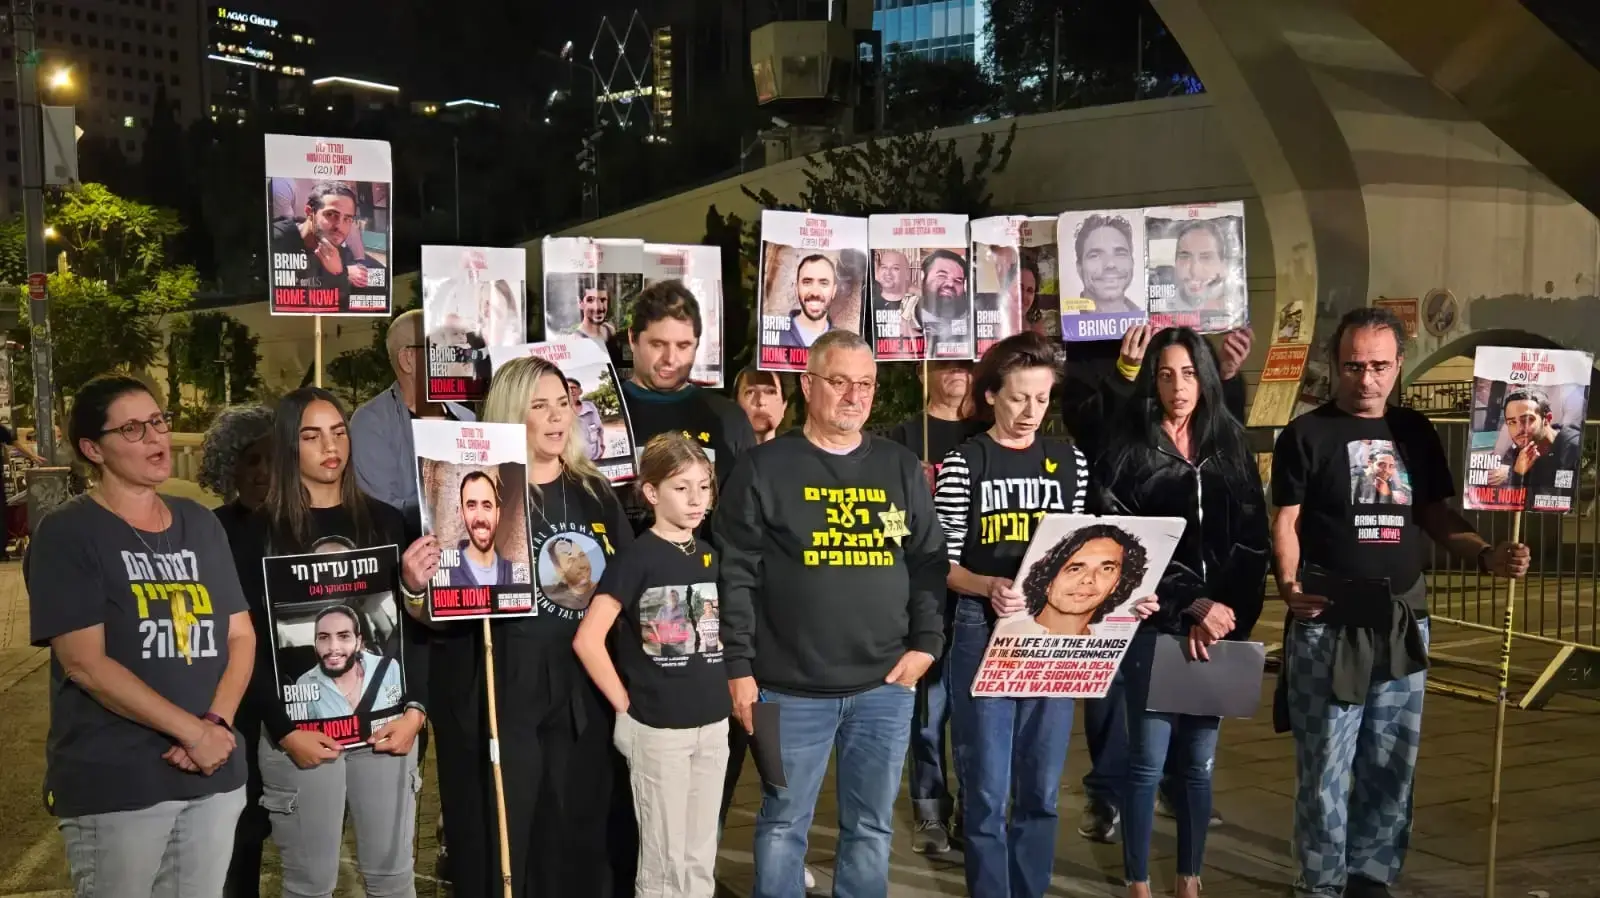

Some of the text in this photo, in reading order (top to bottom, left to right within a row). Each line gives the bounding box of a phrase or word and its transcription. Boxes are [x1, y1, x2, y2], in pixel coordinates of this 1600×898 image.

[249, 14, 279, 28] GROUP
[332, 154, 353, 164] COHEN
[313, 164, 333, 176] (20)
[273, 253, 308, 270] BRING
[274, 270, 296, 287] HIM
[275, 287, 339, 306] HOME NOW!
[1149, 284, 1176, 299] BRING
[762, 315, 791, 331] BRING
[977, 324, 994, 338] HER
[1078, 319, 1117, 337] BRING
[762, 330, 780, 345] HIM
[430, 346, 456, 362] BRING
[762, 346, 788, 362] HOME
[877, 339, 901, 353] HOME
[1509, 371, 1528, 381] (20)
[431, 378, 456, 393] HOME
[456, 438, 467, 449] TAL
[1470, 453, 1501, 469] BRING
[1468, 469, 1489, 485] HIM
[804, 487, 887, 503] שובתים
[981, 476, 1065, 513] בלעדיהם
[1467, 487, 1527, 504] HOME NOW!
[981, 512, 1030, 545] הבית!
[1354, 514, 1404, 527] BRING NIMROD
[550, 521, 595, 537] SHOHA
[1358, 527, 1401, 541] HOME NOW!
[812, 528, 885, 547] להצלת
[120, 548, 199, 582] למה הם
[438, 549, 461, 567] RING
[803, 550, 895, 566] החטופים
[291, 557, 379, 583] מתן עדיין חי
[309, 584, 324, 596] (24)
[433, 585, 491, 608] HOME NOW!
[558, 608, 573, 620] TAL
[994, 637, 1013, 648] MY
[1014, 637, 1042, 648] LIFE
[1042, 638, 1051, 648] IS
[1062, 638, 1086, 648] THE
[1086, 638, 1128, 649] HANDS
[1010, 648, 1052, 658] ISRAELI
[1052, 649, 1123, 659] GOVERNMENT
[984, 660, 1115, 670] IF THEY DON'T SIGN A DEAL
[982, 670, 1113, 681] THEY ARE SIGNING MY
[283, 683, 321, 703] BRING
[975, 681, 1106, 693] DEATH WARRANT!
[285, 703, 309, 721] HIM
[323, 714, 360, 738] NOW!
